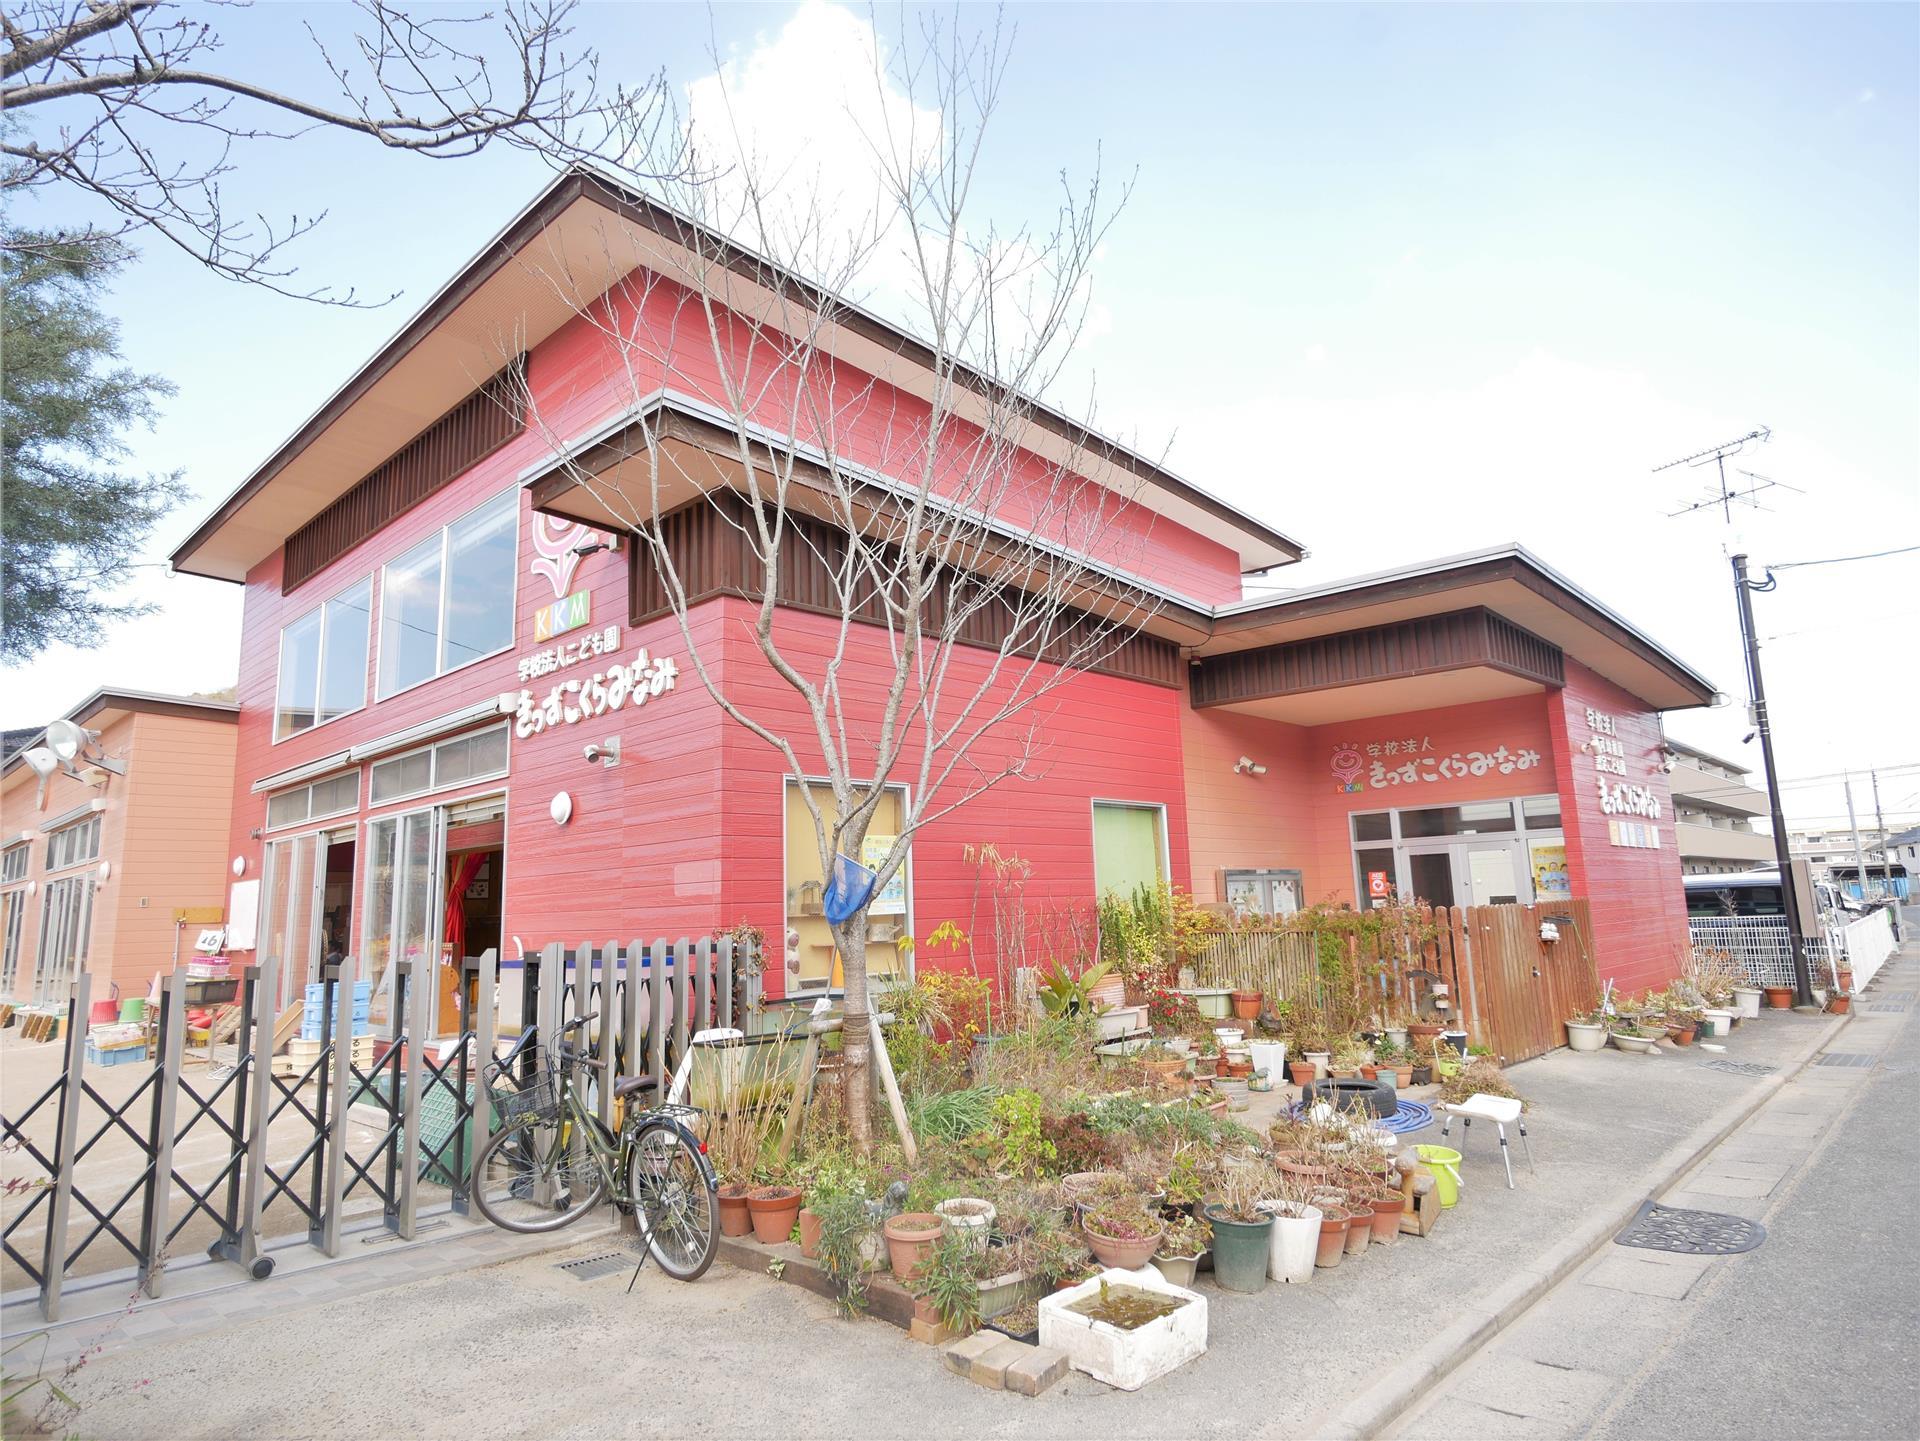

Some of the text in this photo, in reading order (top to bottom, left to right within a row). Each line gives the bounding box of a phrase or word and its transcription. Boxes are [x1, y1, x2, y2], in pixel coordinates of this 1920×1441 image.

[537, 591, 586, 637] KKM
[515, 648, 679, 738] きっずこくらみなみ
[1366, 736, 1435, 758] 学校法人
[1369, 744, 1541, 789] きっずこくらみなみ
